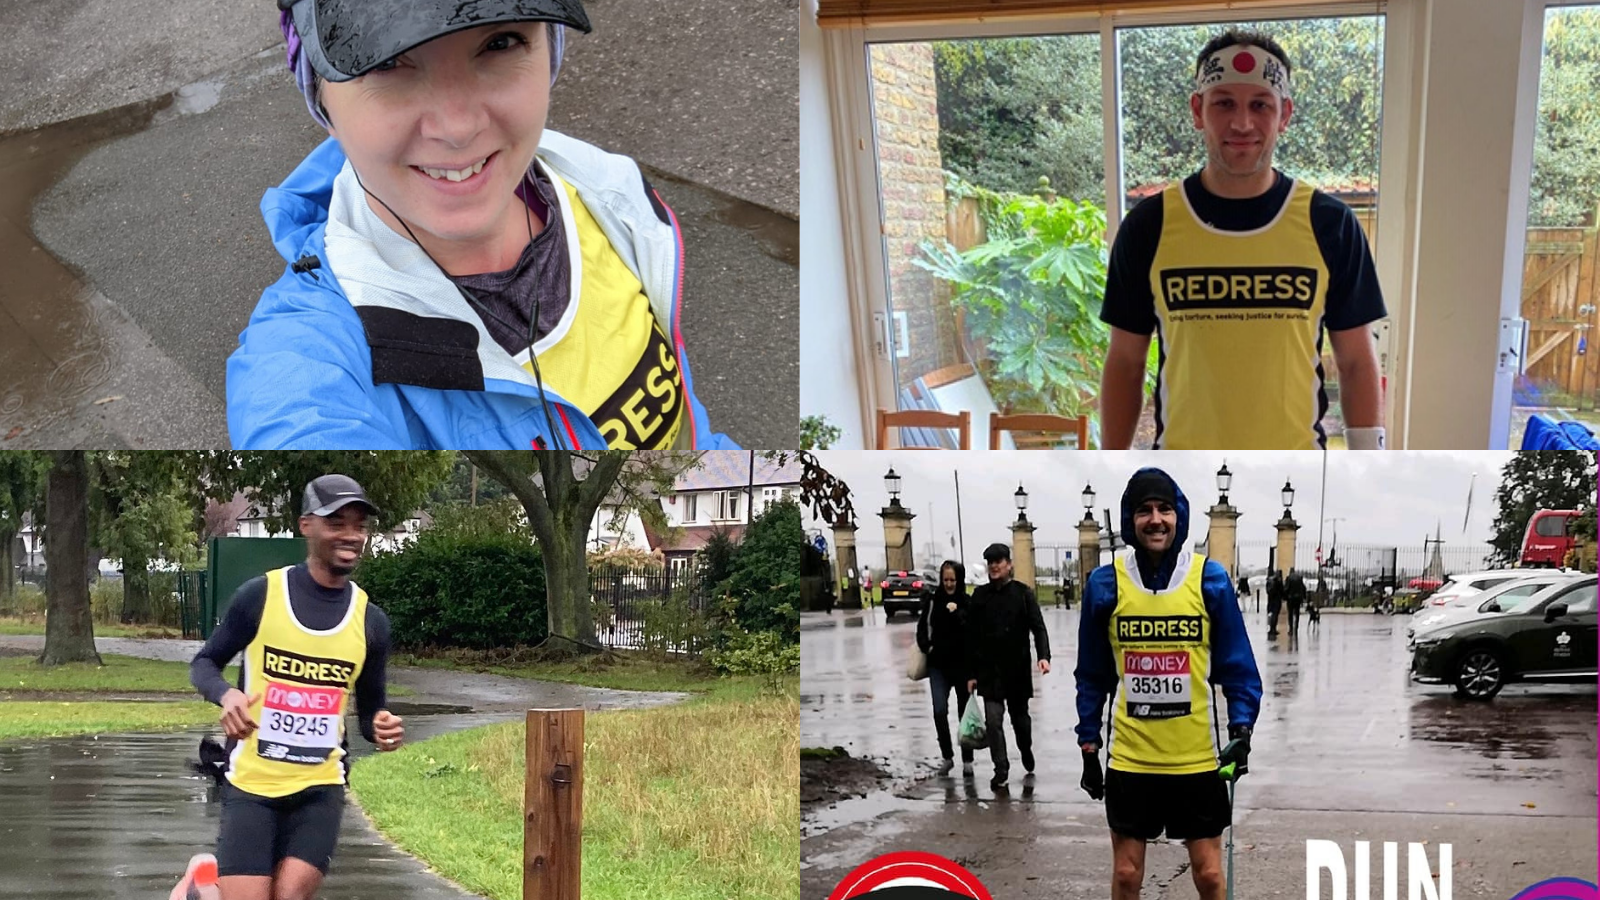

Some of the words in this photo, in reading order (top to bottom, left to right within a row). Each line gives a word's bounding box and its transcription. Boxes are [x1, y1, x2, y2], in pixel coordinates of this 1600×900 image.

[1165, 274, 1312, 303] REDRESS
[1215, 312, 1244, 321] seeking
[1245, 311, 1272, 321] justice
[1273, 311, 1285, 319] for
[1119, 620, 1200, 637] REDRESS
[264, 651, 353, 682] REDRESS
[1126, 655, 1187, 671] MONEY
[1131, 677, 1183, 694] 35316
[266, 686, 339, 710] MONEY
[270, 711, 328, 736] 39245
